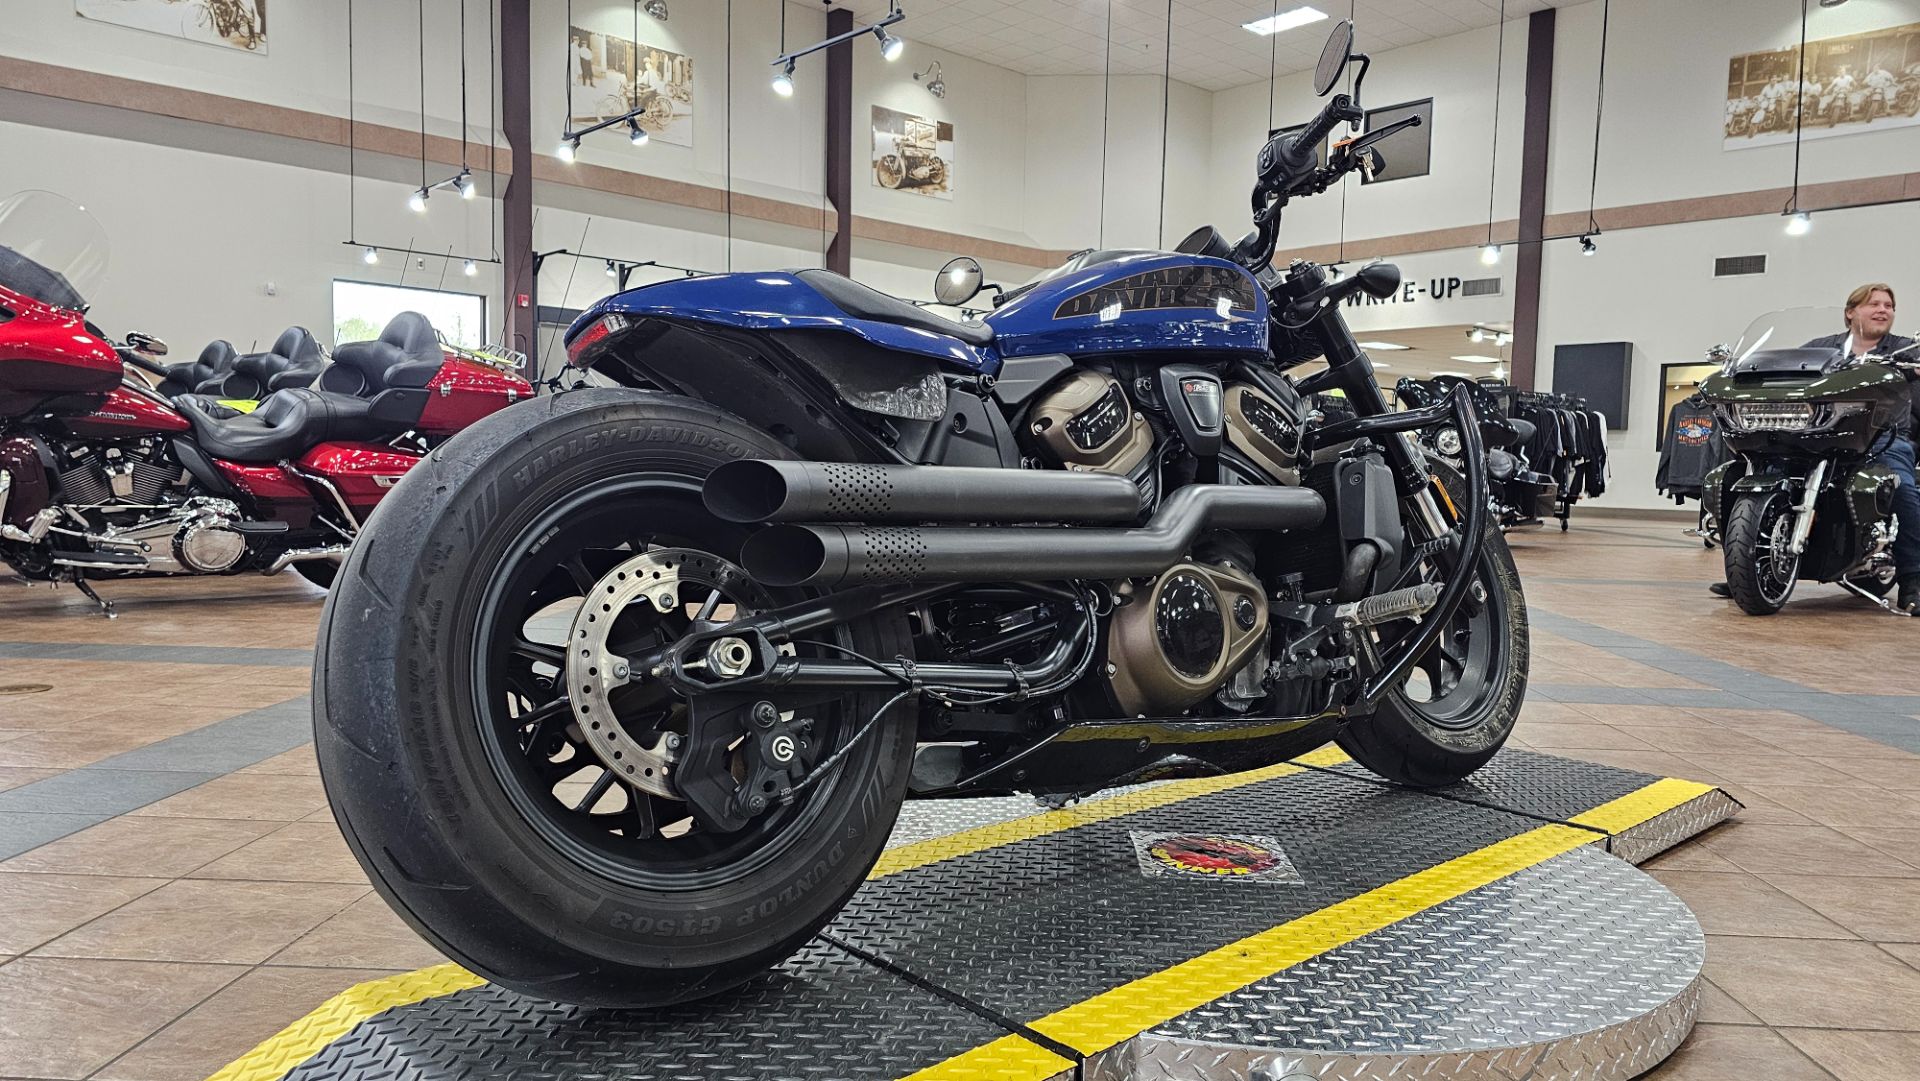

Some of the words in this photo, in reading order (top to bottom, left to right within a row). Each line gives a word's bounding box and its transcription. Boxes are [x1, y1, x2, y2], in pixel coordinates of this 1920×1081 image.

[1346, 277, 1461, 307] WE-UP
[735, 840, 846, 927] DUNLOP
[609, 910, 723, 937] GT503
